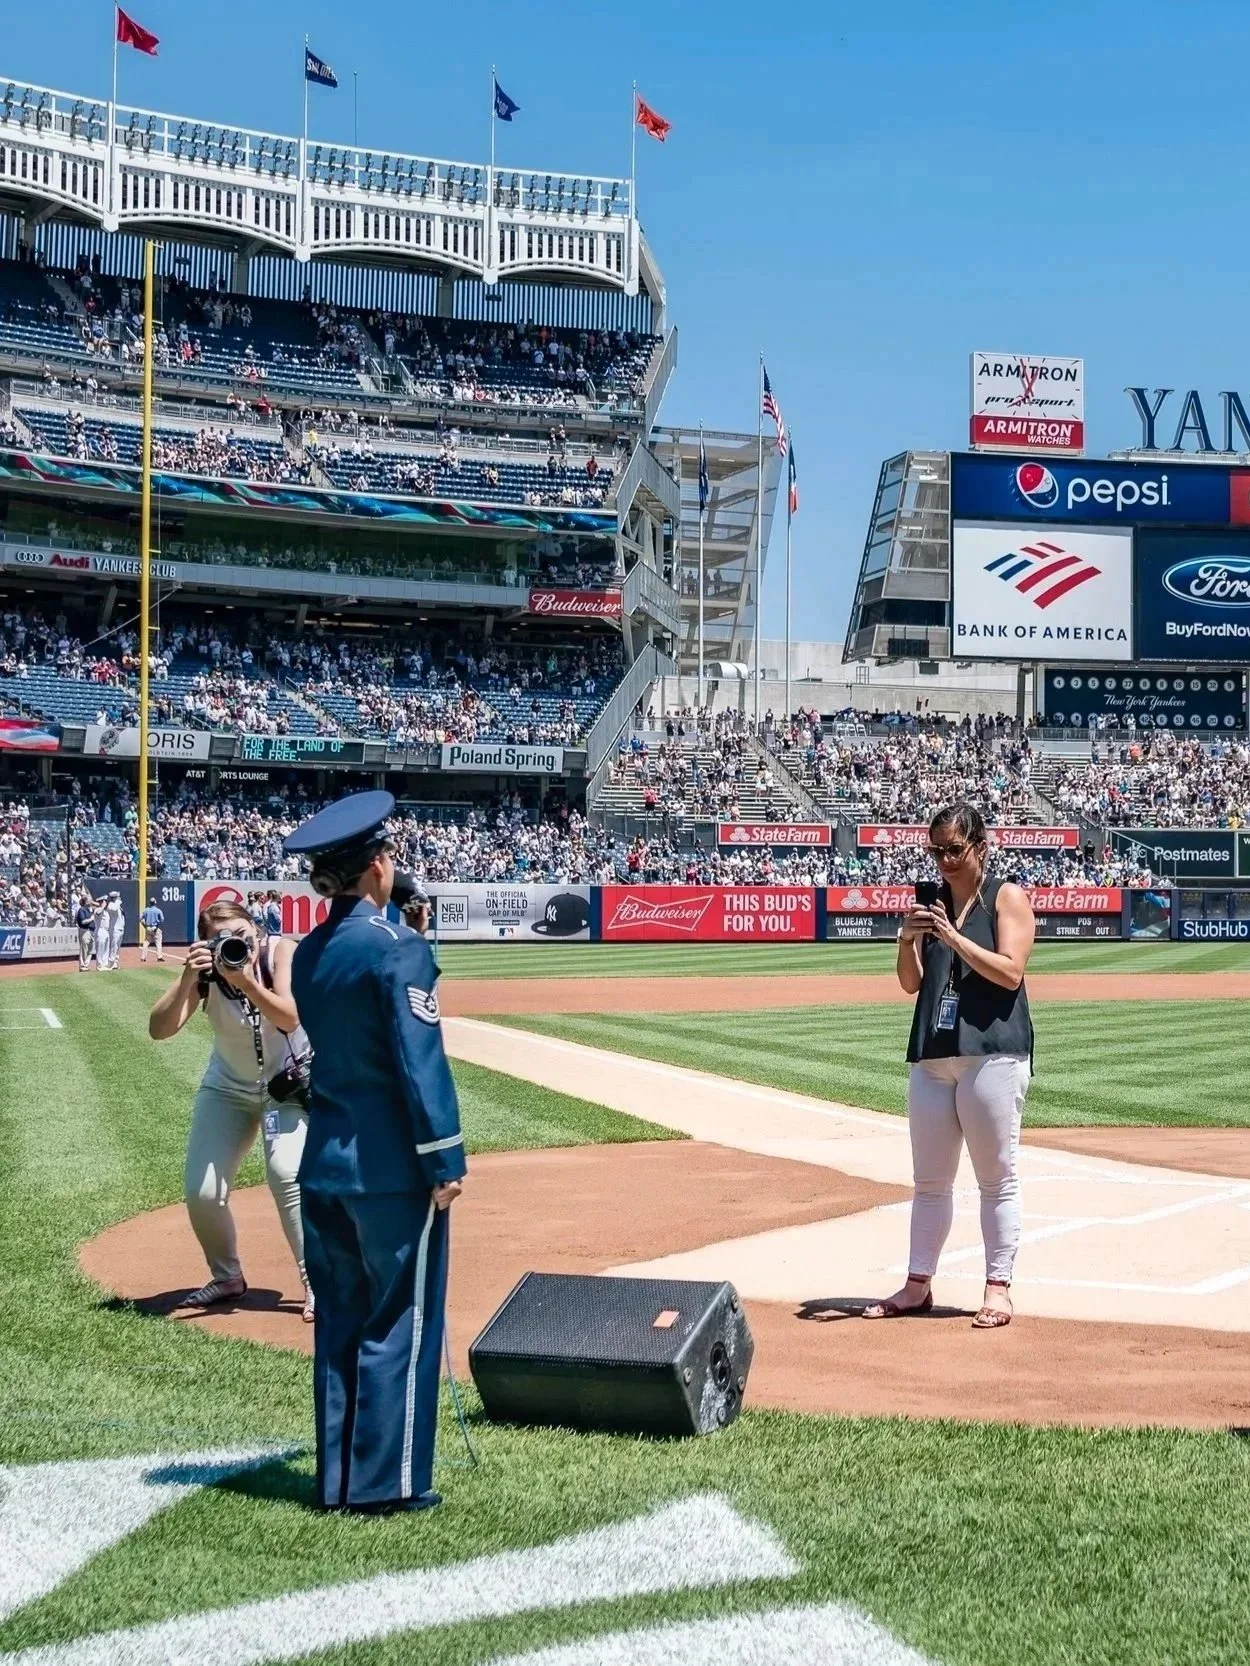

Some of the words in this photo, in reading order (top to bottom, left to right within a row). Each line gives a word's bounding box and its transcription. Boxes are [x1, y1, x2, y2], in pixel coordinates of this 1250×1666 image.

[979, 362, 1077, 382] ARMITRON
[984, 420, 1072, 437] ARMITRON
[1027, 435, 1071, 445] WATCHES
[1067, 475, 1167, 511] pepsi
[51, 554, 90, 569] Audi
[150, 564, 176, 578] CLUB
[531, 593, 621, 613] Budweiser
[957, 624, 1009, 639] BANK
[1013, 625, 1038, 640] OF
[1043, 625, 1128, 641] AMERICA
[1103, 694, 1125, 705] New
[1126, 695, 1148, 710] York
[1149, 695, 1186, 710] Yankees
[147, 732, 195, 750] ORIS
[244, 738, 264, 751] FOR
[271, 739, 290, 751] THE
[296, 739, 325, 753] LAND
[331, 740, 345, 753] OF
[244, 750, 263, 760] THE
[268, 750, 301, 761] FREE.
[450, 746, 501, 766] Poland
[505, 748, 555, 772] Spring
[186, 769, 206, 779] AT&T
[219, 771, 238, 781] ORTS
[238, 772, 269, 781] LOUNGE
[1154, 846, 1230, 862] Postmates
[441, 903, 464, 912] NEW
[486, 899, 528, 909] ON-FIELD
[723, 894, 759, 912] THIS
[764, 894, 812, 912] BUD'S
[441, 913, 464, 923] ERA
[616, 902, 703, 921] Budweiser
[723, 914, 754, 932] FOR
[760, 914, 796, 932] YOU.
[835, 917, 873, 926] BLUEJAYS
[1077, 917, 1091, 926] POS
[1183, 920, 1248, 938] StubHub
[837, 927, 872, 937] YANKEES
[1056, 927, 1080, 935] STRIKE
[1095, 927, 1109, 935] OUT
[2, 934, 22, 950] ACC
